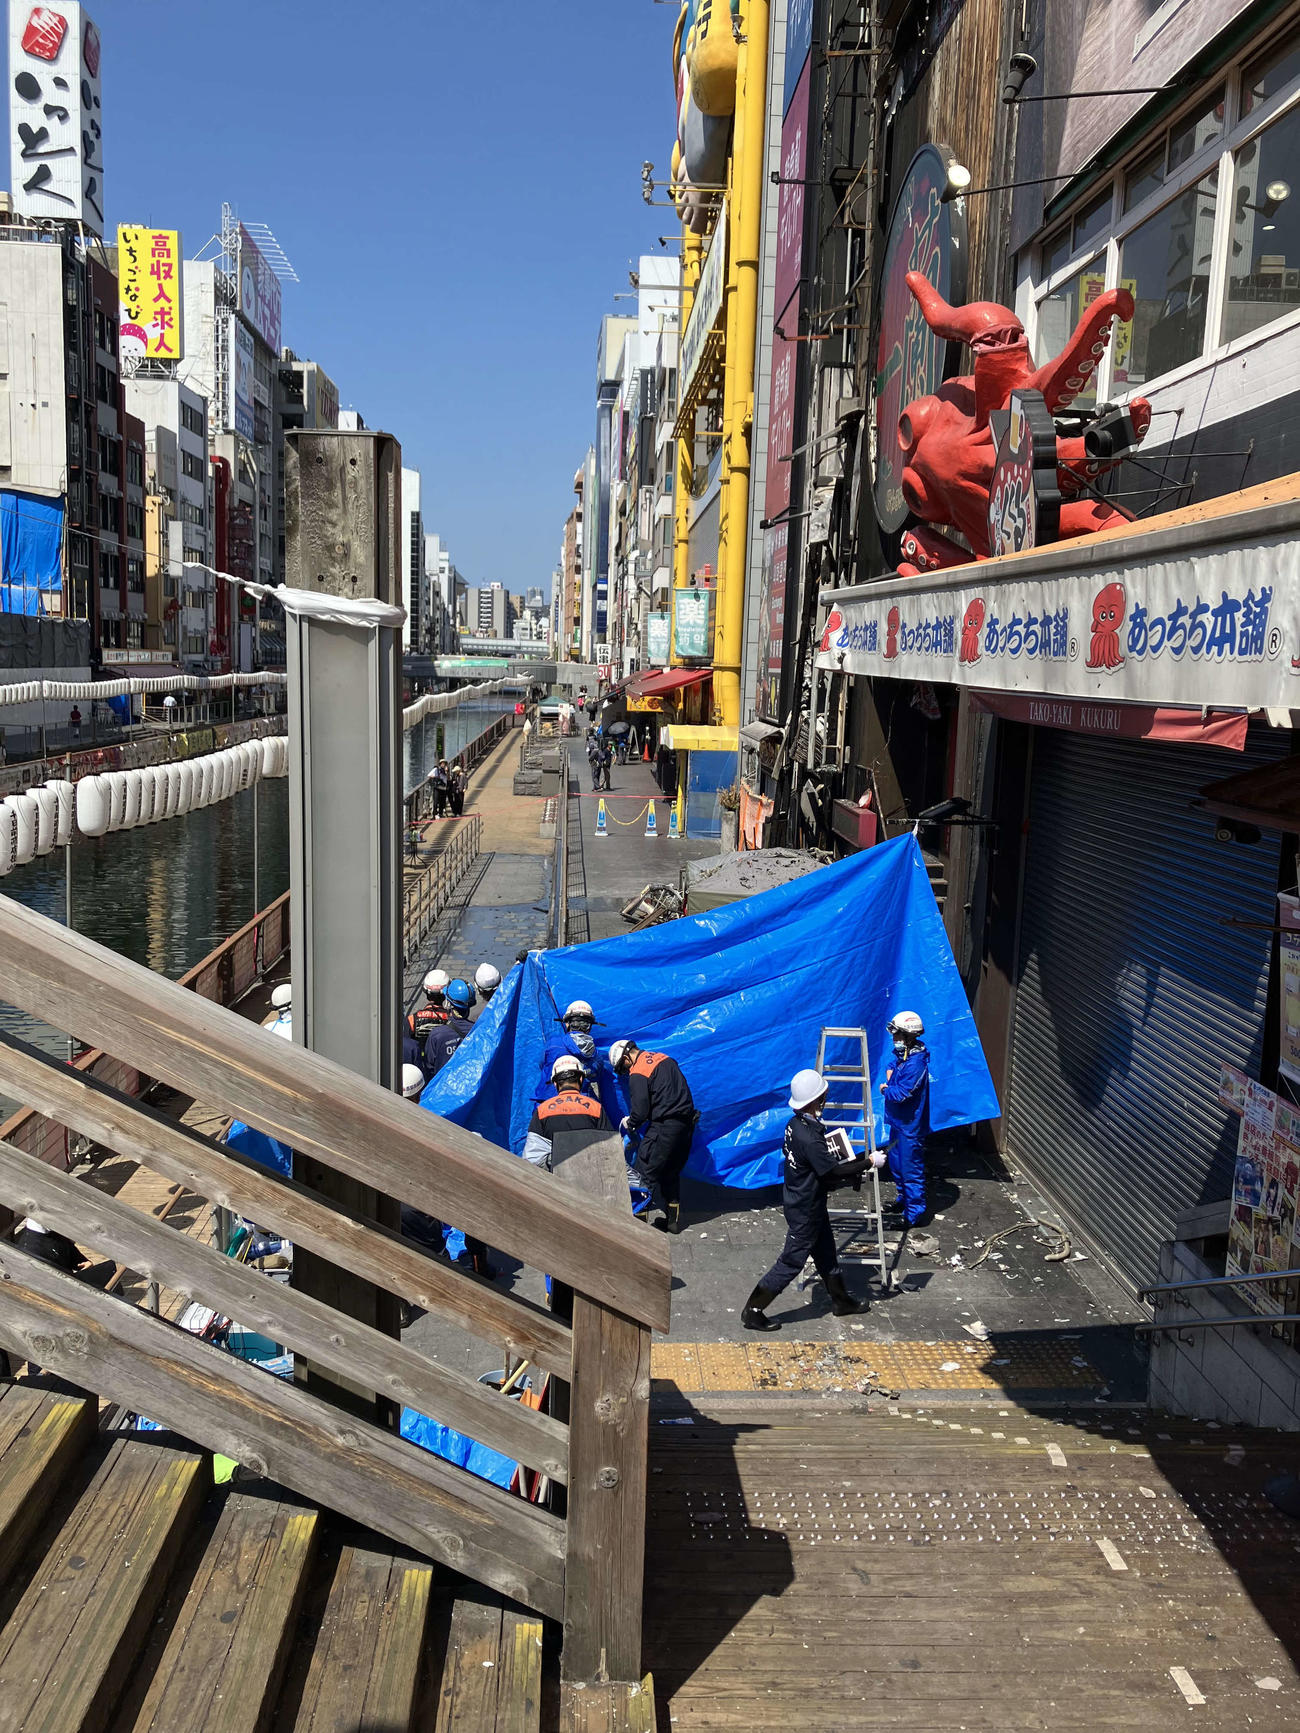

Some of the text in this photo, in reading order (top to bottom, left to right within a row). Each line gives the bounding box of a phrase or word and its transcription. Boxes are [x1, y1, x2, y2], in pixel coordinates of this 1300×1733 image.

[14, 71, 77, 208] いっとく
[81, 79, 104, 224] いっとく
[123, 231, 144, 321] いちごなび
[149, 233, 175, 355] 高収入求人
[678, 598, 706, 626] 薬
[900, 614, 955, 654] あっちち本舗
[985, 607, 1069, 658] あっちち本舗
[1127, 586, 1273, 660] あっちち本舗
[598, 645, 610, 665] 伝串
[1080, 707, 1121, 730] KUKURU
[548, 1095, 591, 1111] OSAKA
